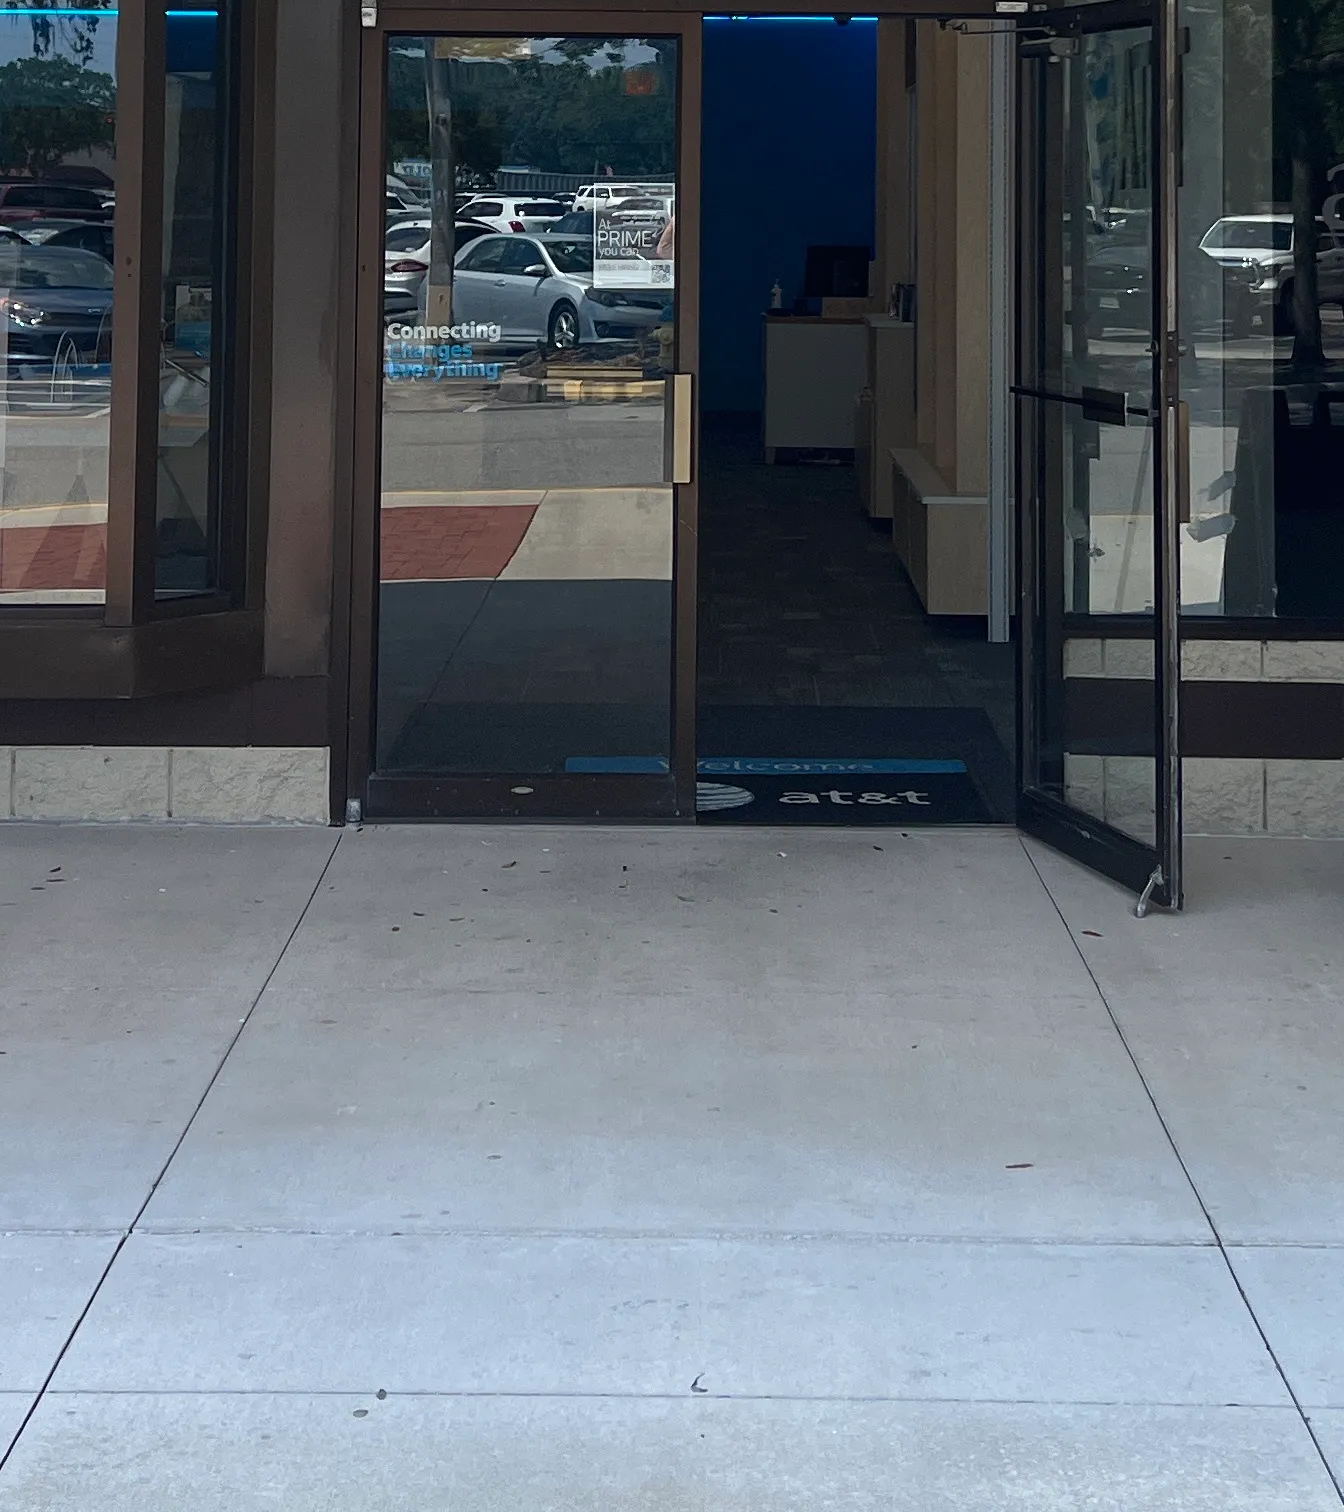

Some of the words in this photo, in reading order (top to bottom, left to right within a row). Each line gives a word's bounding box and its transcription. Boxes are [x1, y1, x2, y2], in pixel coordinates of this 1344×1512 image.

[599, 218, 611, 229] At
[597, 231, 652, 247] PRIME
[599, 248, 618, 258] you
[620, 248, 639, 257] can
[388, 321, 501, 342] Connecting
[778, 790, 932, 806] at&t
